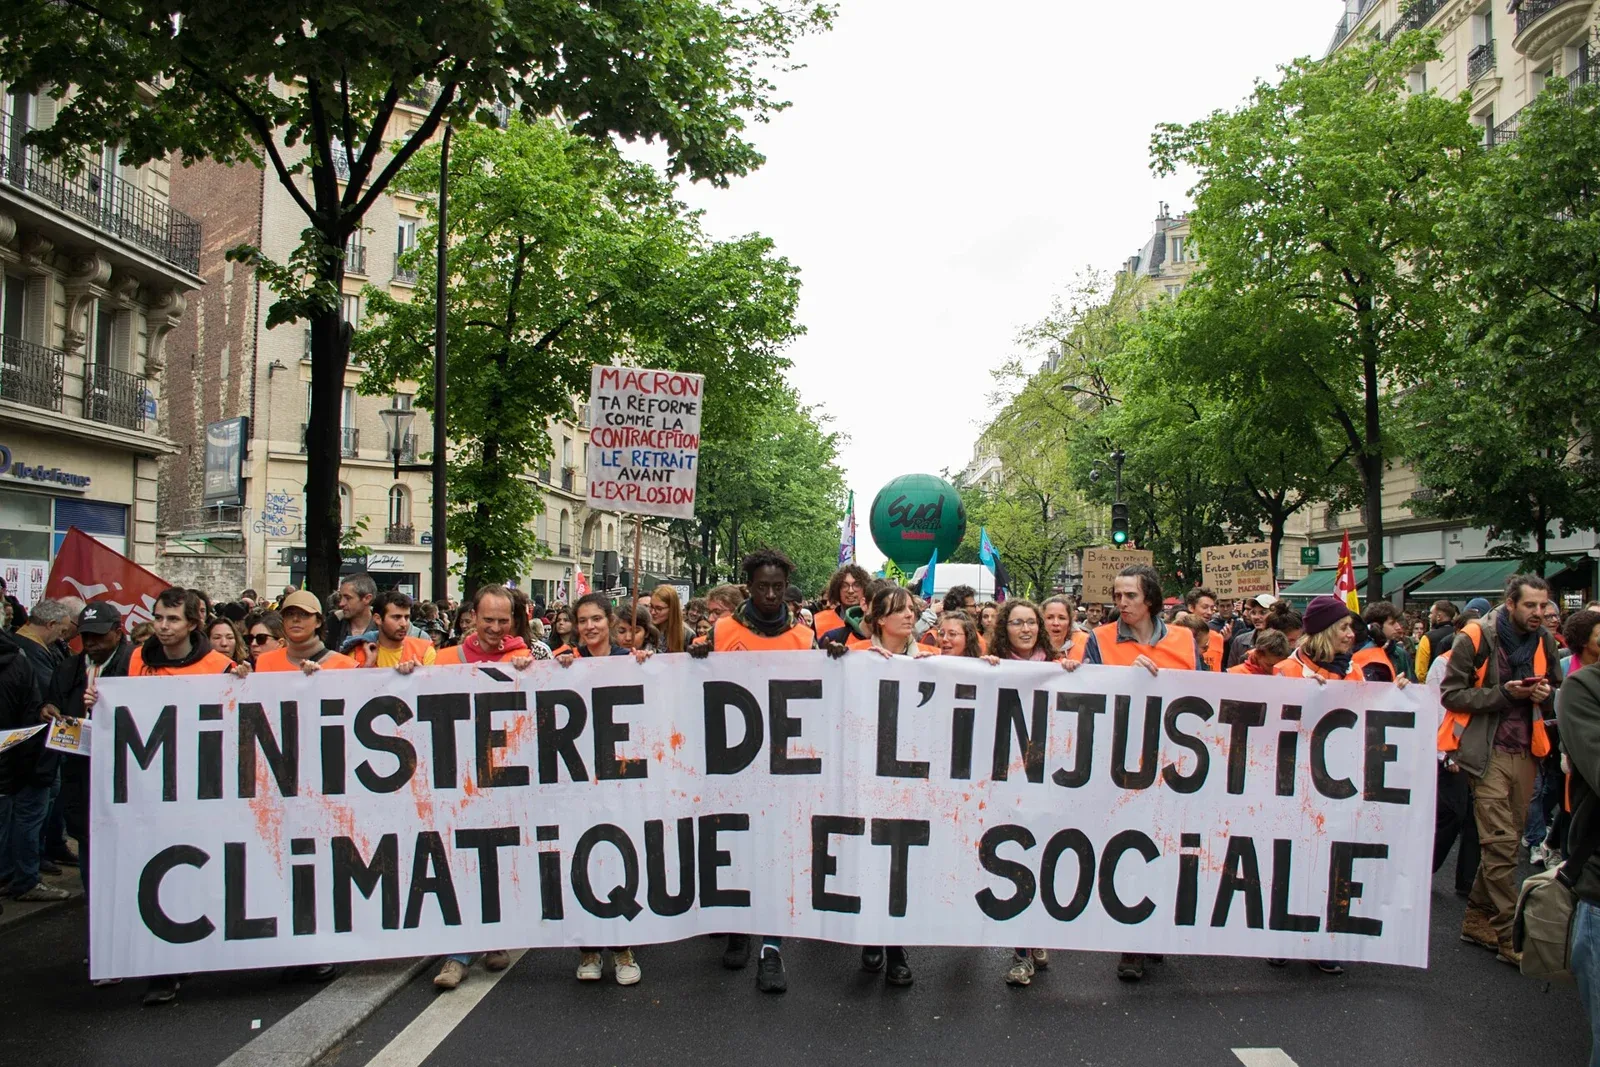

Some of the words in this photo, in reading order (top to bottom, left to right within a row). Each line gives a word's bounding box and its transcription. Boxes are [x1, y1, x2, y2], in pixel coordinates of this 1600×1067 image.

[600, 368, 699, 396] MACRON
[598, 396, 620, 410] TA
[627, 394, 697, 415] RÉFORME
[605, 412, 655, 427] COMME
[663, 418, 684, 430] LA
[590, 427, 699, 449] CONTRACEPTION
[601, 451, 622, 467] LE
[618, 467, 675, 482] AVANT
[591, 481, 694, 504] L'EXPLOSION
[888, 494, 945, 528] Sud
[5, 567, 18, 582] ON
[31, 568, 42, 582] ON
[1241, 559, 1270, 570] VOTER
[702, 679, 823, 776] DE
[811, 814, 931, 918] ET
